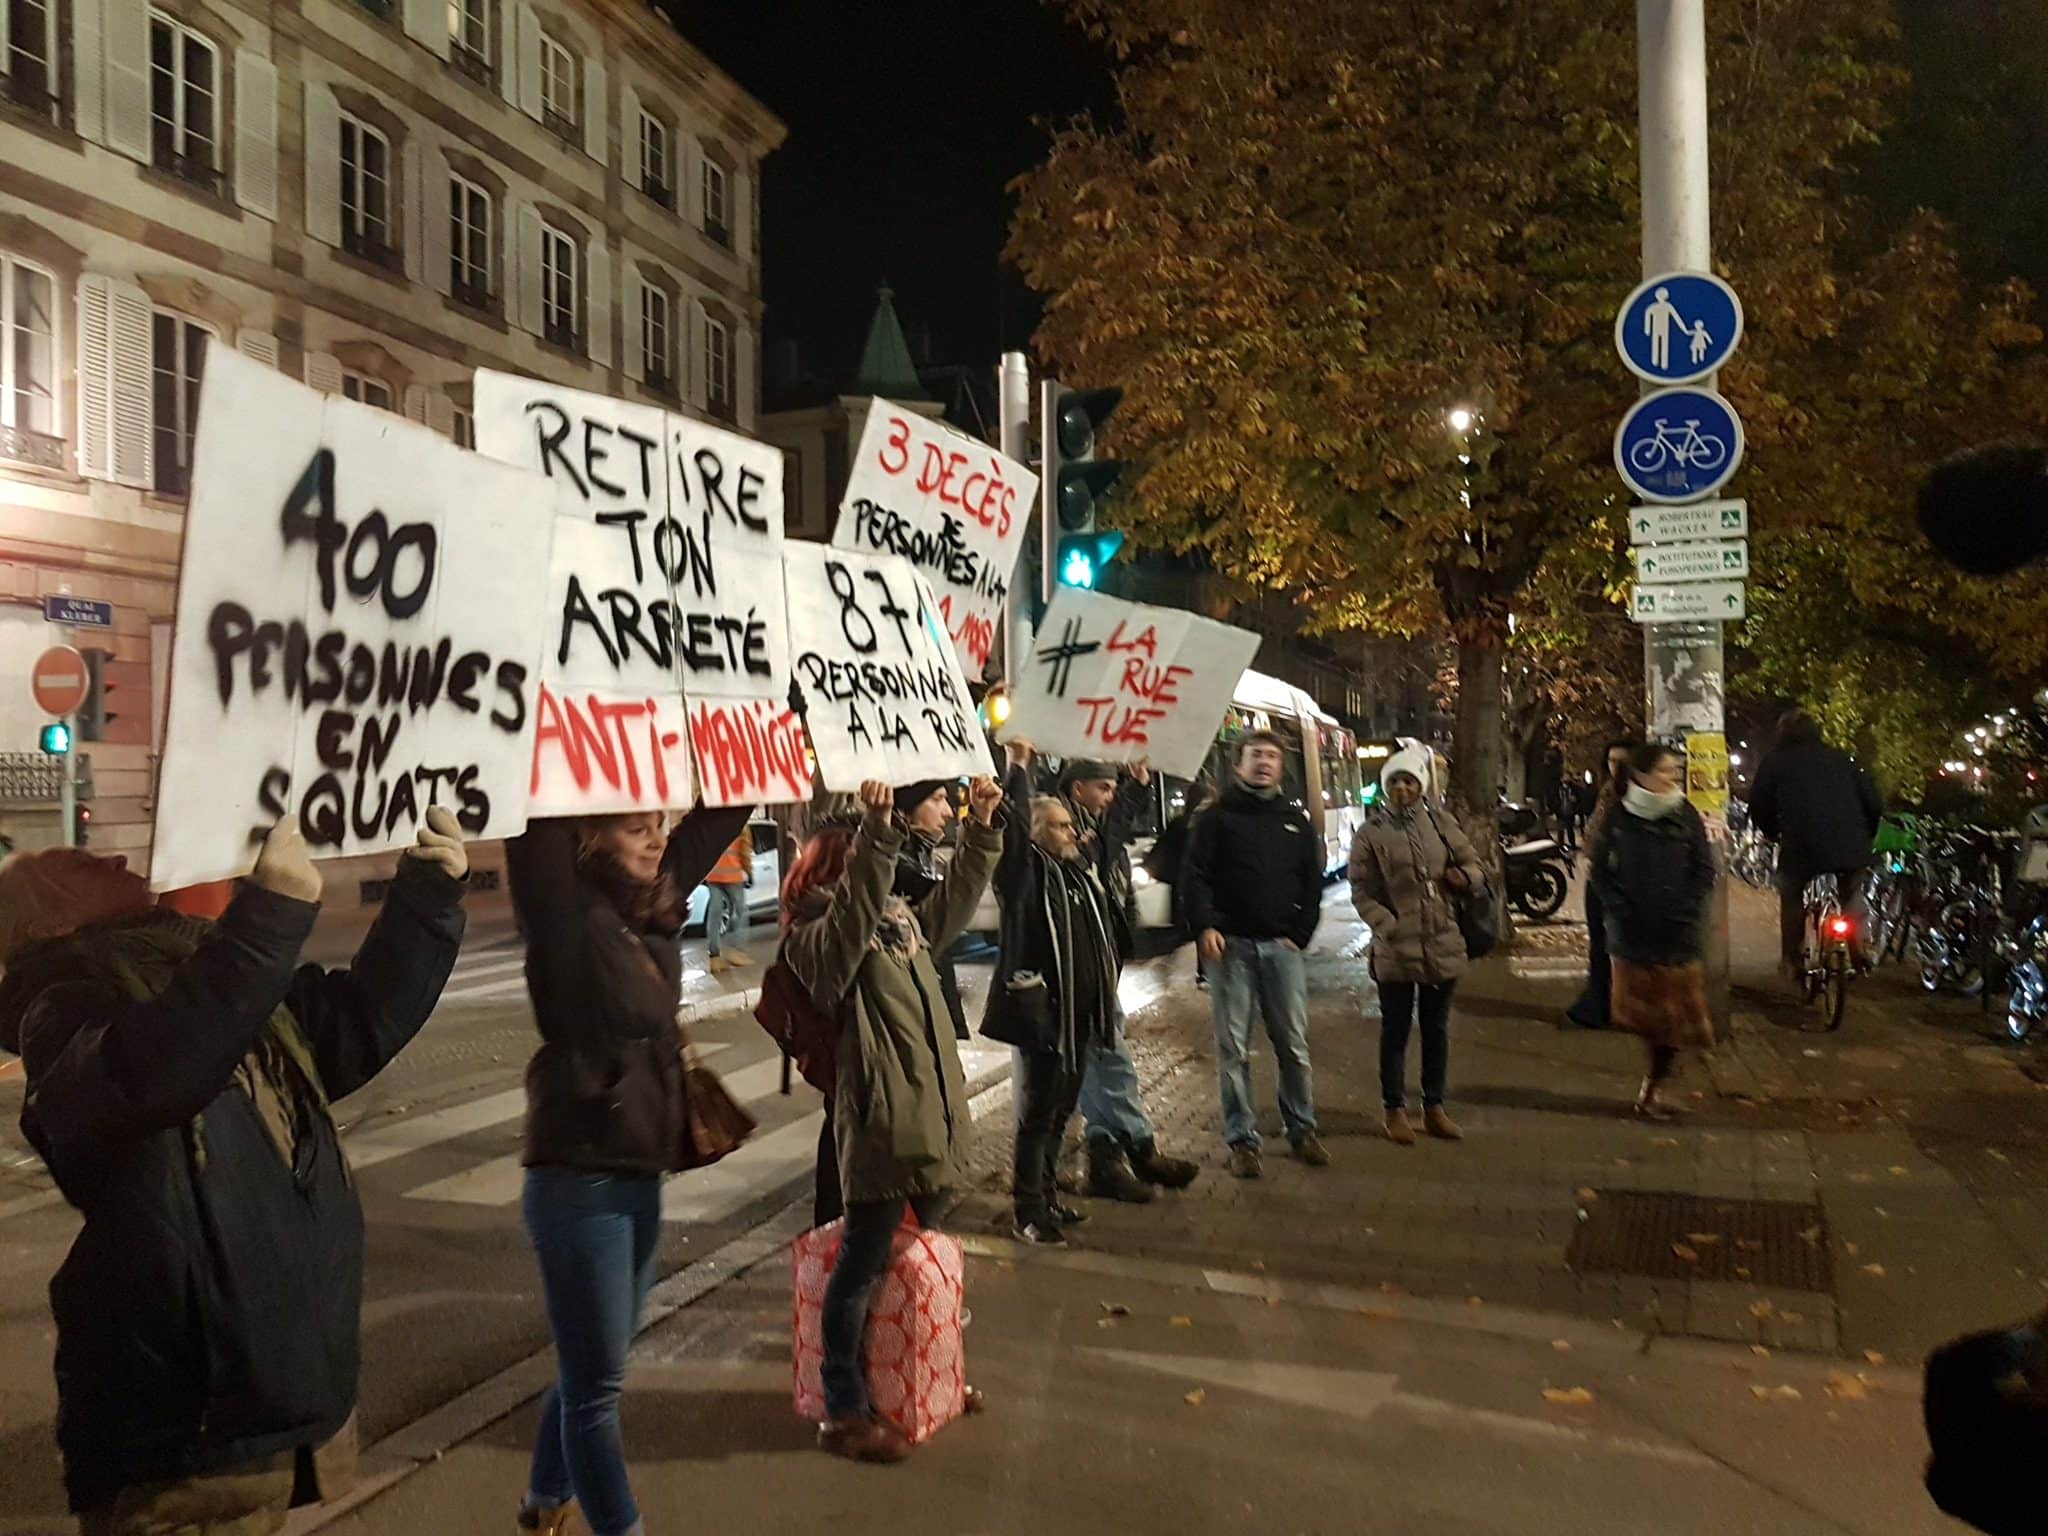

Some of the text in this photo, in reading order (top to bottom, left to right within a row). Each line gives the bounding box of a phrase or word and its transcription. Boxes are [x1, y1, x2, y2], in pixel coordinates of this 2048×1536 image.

[878, 417, 909, 475] 3
[281, 445, 438, 620] 400
[595, 510, 716, 598] TON
[852, 498, 978, 586] PERSONNES
[208, 600, 528, 735] PERSONNES
[1119, 656, 1193, 703] RUE
[315, 710, 400, 777] EN
[881, 706, 919, 752] LA
[921, 708, 976, 752] RUE
[1076, 696, 1167, 745] TUE
[249, 763, 491, 849] SQUATS
